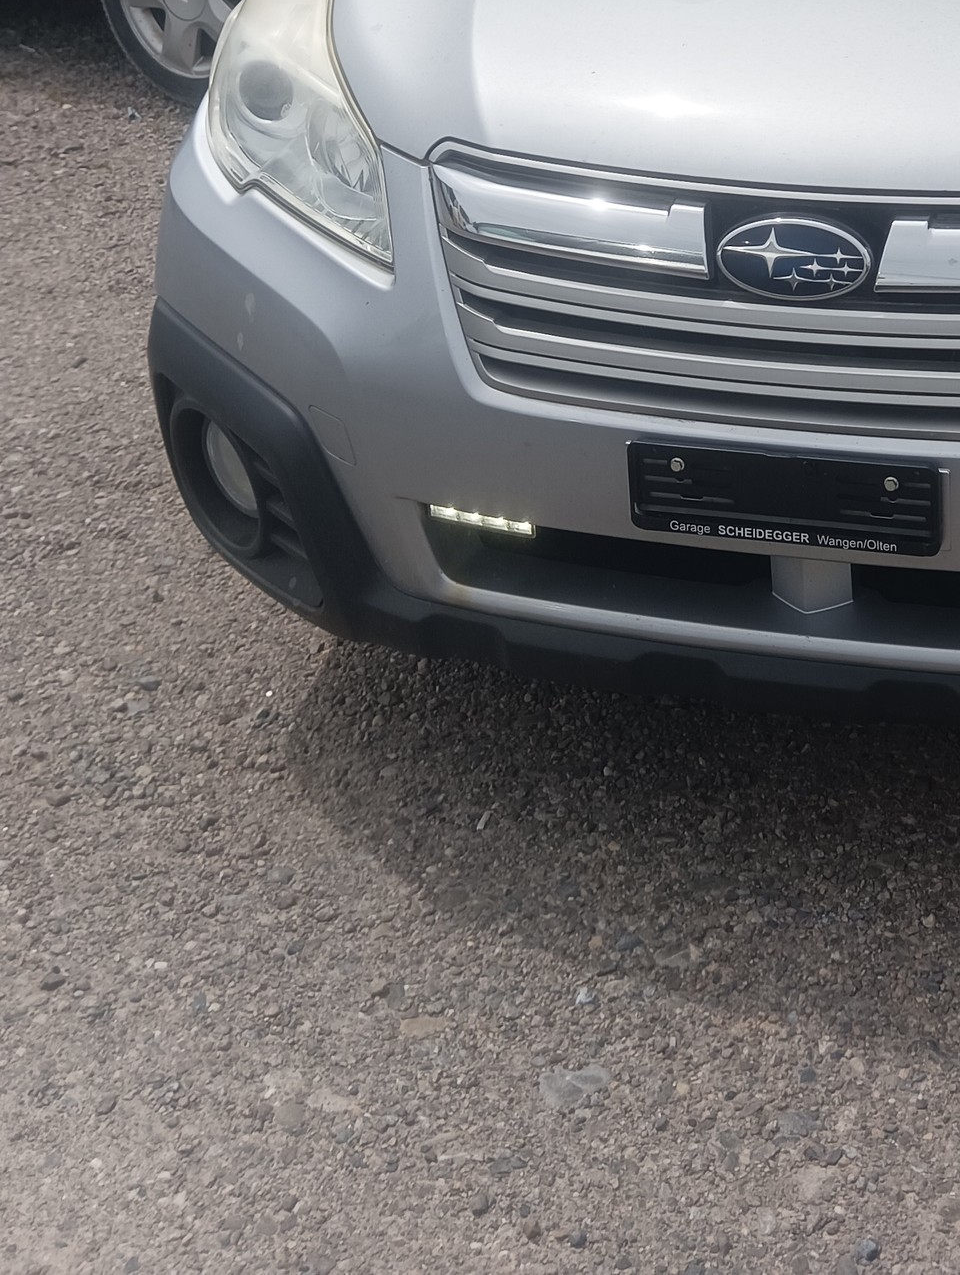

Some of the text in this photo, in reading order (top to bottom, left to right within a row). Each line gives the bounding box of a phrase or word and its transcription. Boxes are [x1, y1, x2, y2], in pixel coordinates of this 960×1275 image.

[669, 519, 898, 553] Garage SCHEIDEGGER Wangen/Olten
